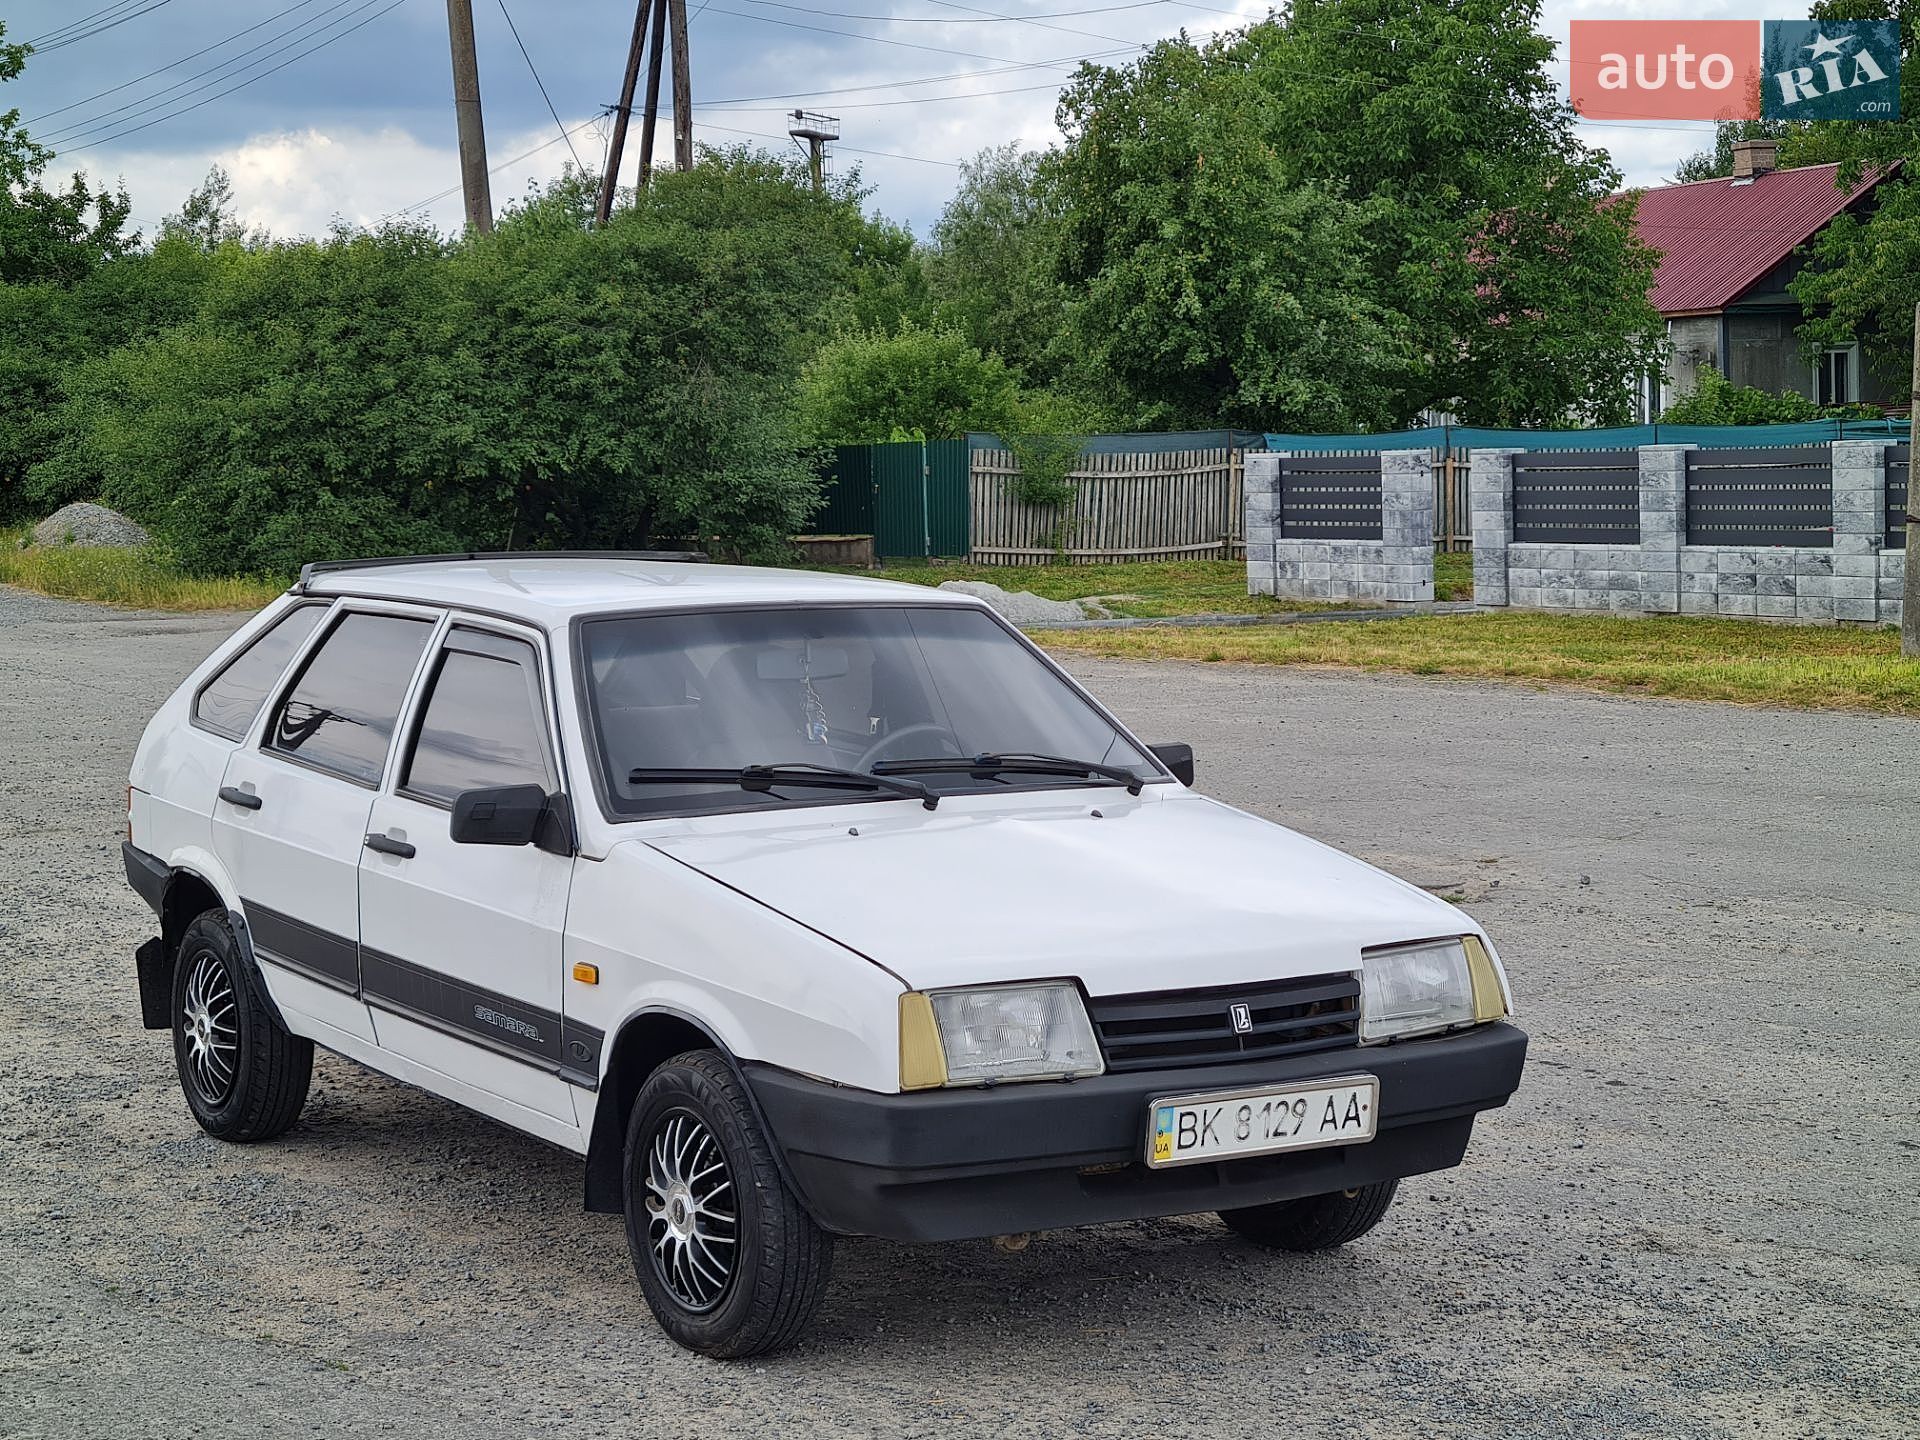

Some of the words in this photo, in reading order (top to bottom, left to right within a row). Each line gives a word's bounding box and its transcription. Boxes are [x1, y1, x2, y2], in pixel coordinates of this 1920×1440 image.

[1177, 1107, 1224, 1150] BK
[1235, 1098, 1307, 1143] 8129
[1320, 1091, 1362, 1132] AA
[1155, 1143, 1169, 1154] UA
